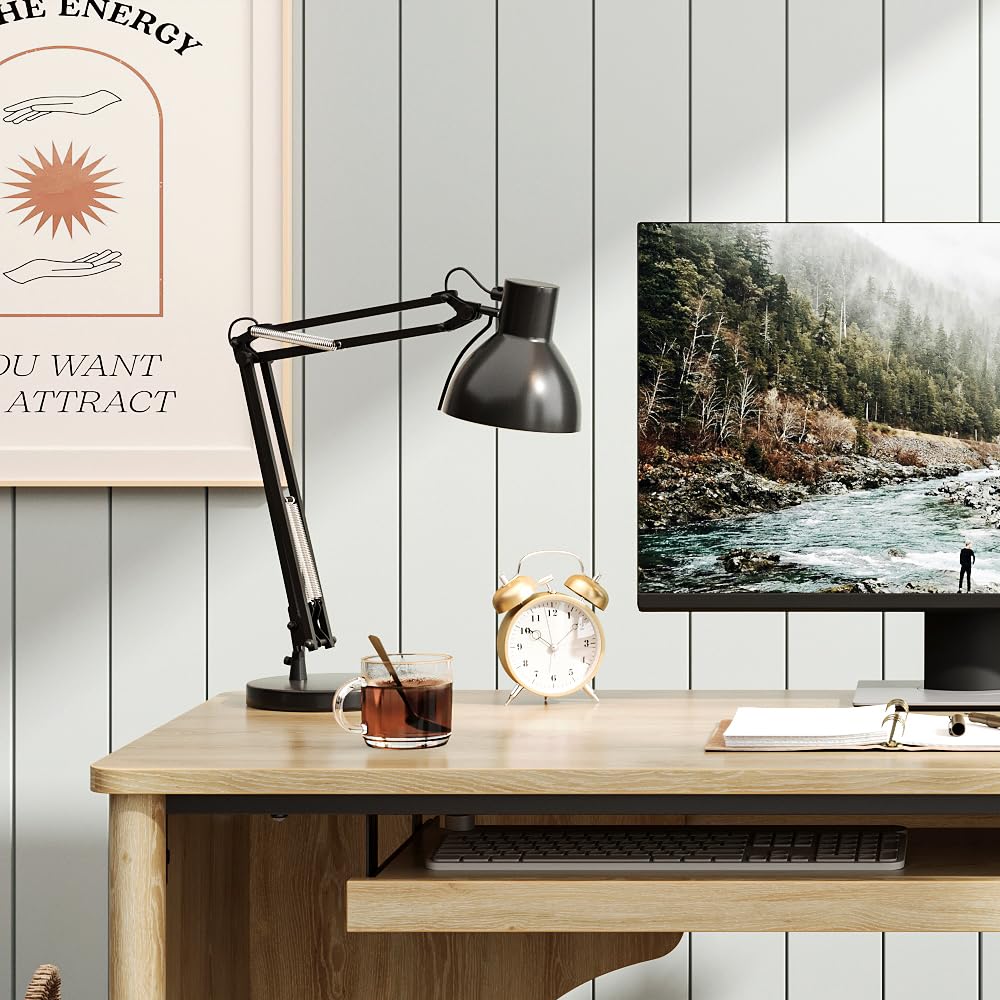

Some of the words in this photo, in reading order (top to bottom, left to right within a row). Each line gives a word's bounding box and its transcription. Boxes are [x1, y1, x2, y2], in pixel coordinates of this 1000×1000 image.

[58, 0, 203, 56] ENERGY
[51, 354, 163, 377] WANT
[4, 390, 177, 414] ATTRACT
[548, 609, 558, 617] 12
[531, 614, 540, 622] 11
[520, 627, 531, 635] 10
[583, 639, 590, 648] 3
